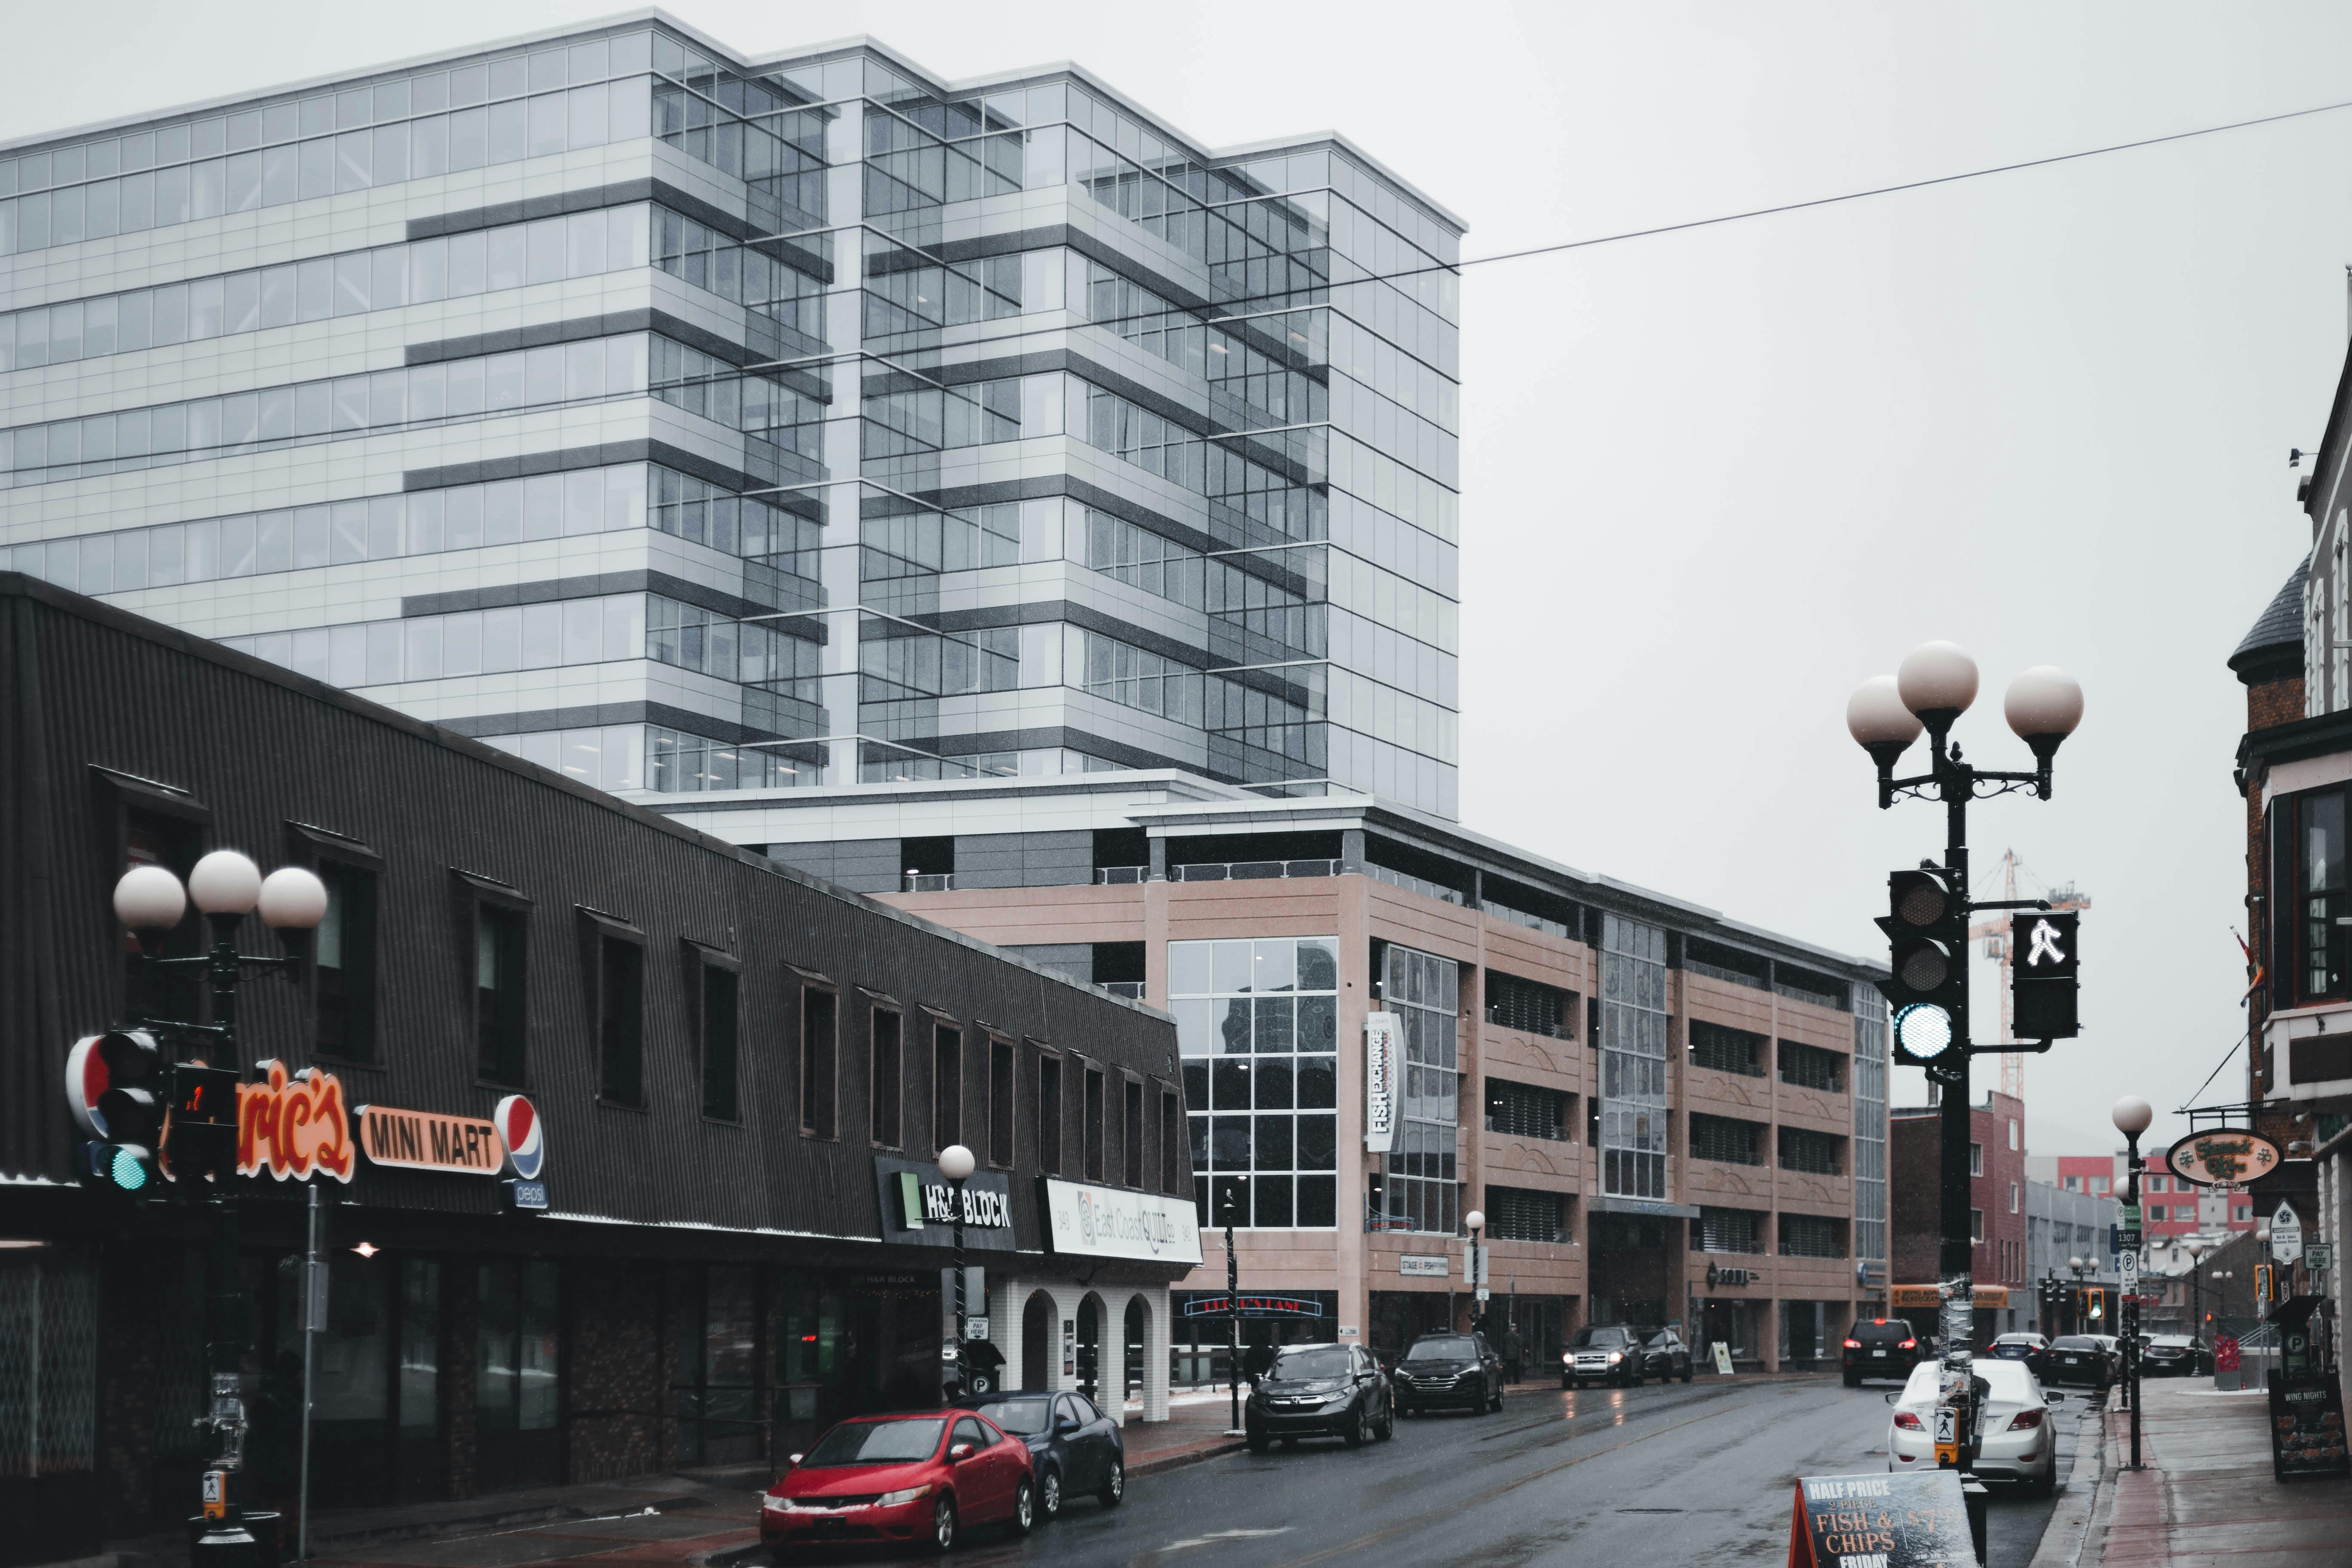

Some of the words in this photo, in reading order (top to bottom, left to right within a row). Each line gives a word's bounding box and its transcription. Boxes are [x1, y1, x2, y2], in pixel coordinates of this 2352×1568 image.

[1372, 1031, 1383, 1093] EXCHANGE
[1372, 1092, 1388, 1133] FISH
[368, 1112, 423, 1162] MINI
[430, 1119, 491, 1168] MART
[2196, 1139, 2252, 1158] Shamrock
[517, 1185, 544, 1204] pepsi
[961, 1189, 1011, 1227] BLOCK
[1058, 1210, 1070, 1230] 343
[1094, 1204, 1116, 1238] East
[1118, 1207, 1143, 1240] Coast
[1142, 1210, 1168, 1254] QUILT
[1182, 1225, 1192, 1242] 343
[1719, 1268, 1749, 1284] SOUL
[2285, 1393, 2302, 1402] WING
[2303, 1390, 2327, 1400] NIGHTS
[1809, 1482, 1846, 1500] HALF
[1848, 1479, 1891, 1498] PRICE
[1829, 1501, 1838, 1511] 2
[1841, 1499, 1877, 1509] PIECE
[1816, 1511, 1869, 1534] FISH
[1877, 1510, 1895, 1529] &
[1826, 1531, 1896, 1554] CHIPS
[1840, 1553, 1888, 1568] FRIDAY
